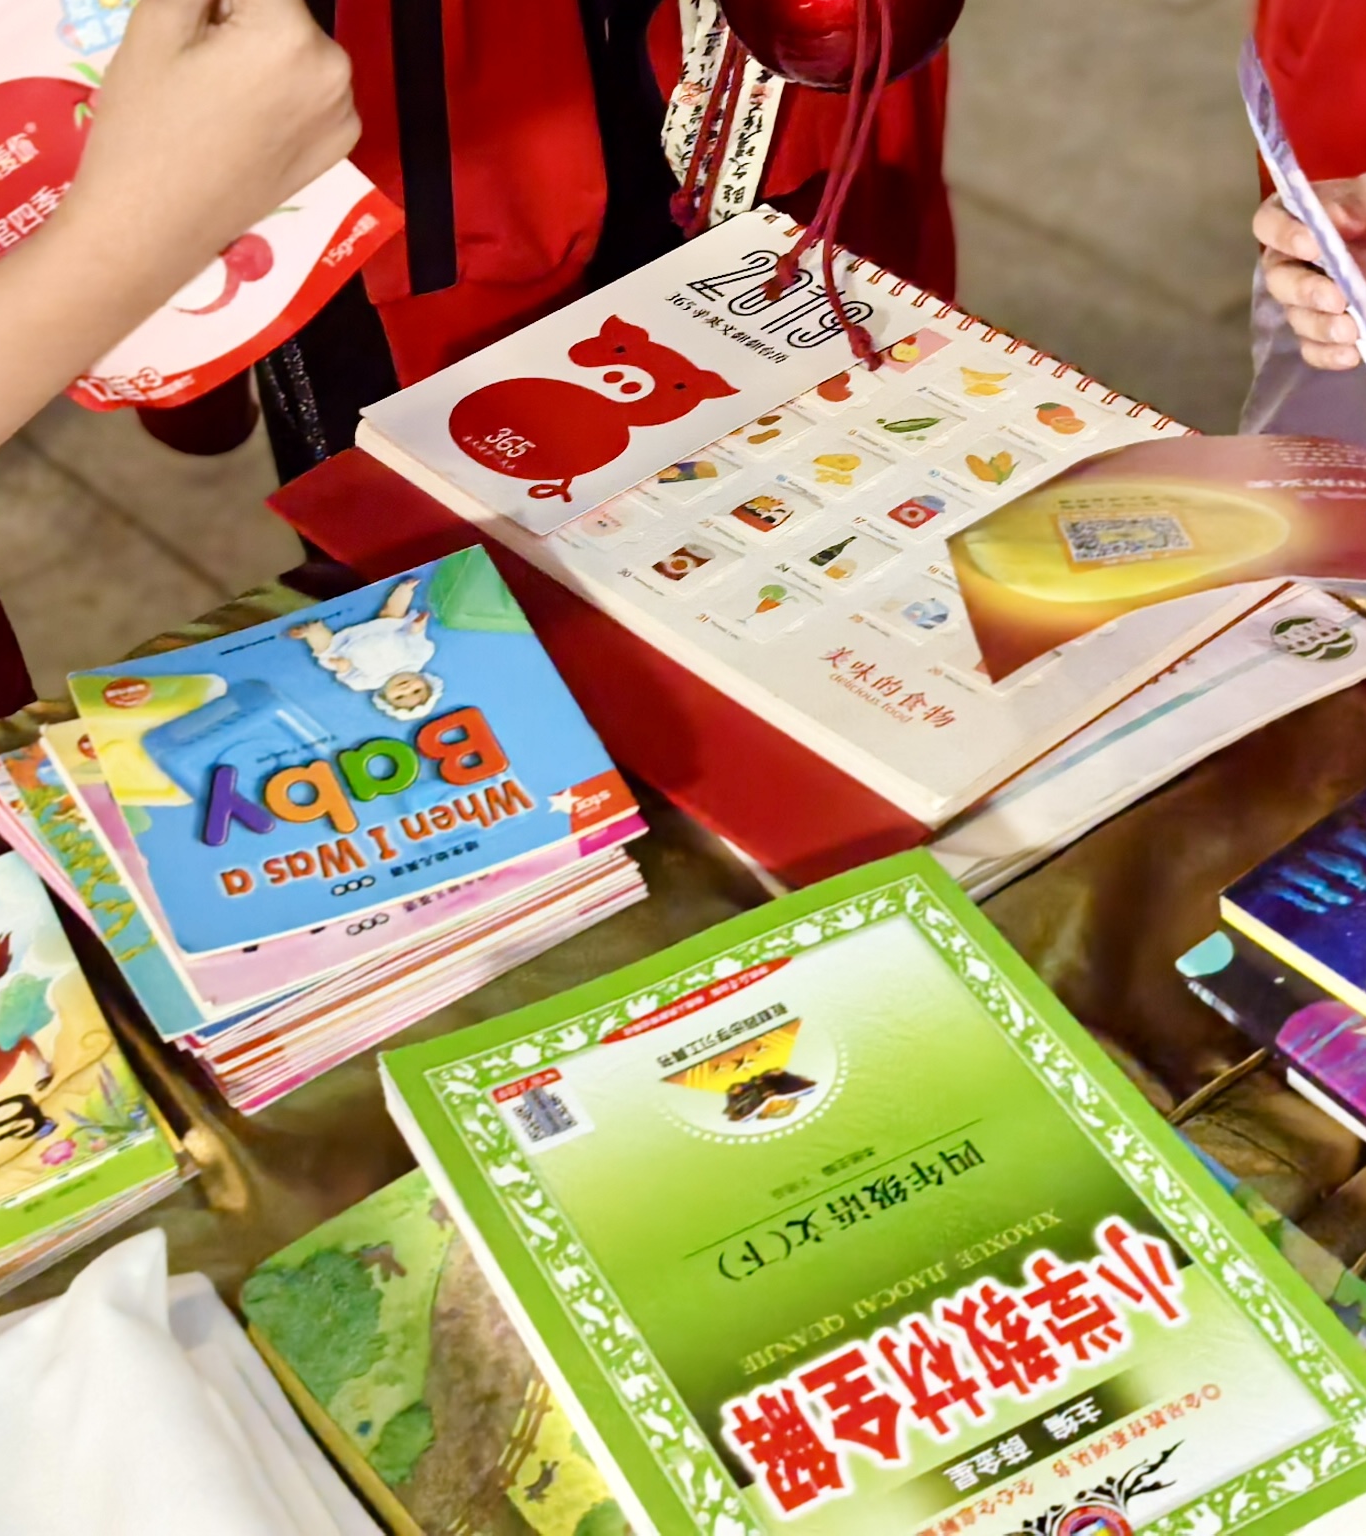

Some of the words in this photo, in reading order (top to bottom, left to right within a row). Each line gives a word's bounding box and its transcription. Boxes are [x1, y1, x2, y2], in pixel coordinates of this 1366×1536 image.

[687, 248, 876, 352] 2019
[484, 426, 536, 461] 365
[819, 645, 957, 729] 美味的食物
[202, 706, 511, 847] Baby
[403, 778, 534, 844] When
[267, 839, 361, 885] Was
[375, 828, 399, 862] I
[222, 865, 256, 898] a
[955, 1207, 1063, 1268] XIAOXUE
[853, 1262, 948, 1319] JIAOCAI
[731, 1222, 1179, 1513] 小学教材全解
[740, 1314, 846, 1375] QUANJIE
[1042, 1396, 1103, 1440] 主编
[942, 1433, 1034, 1492] 薛金星
